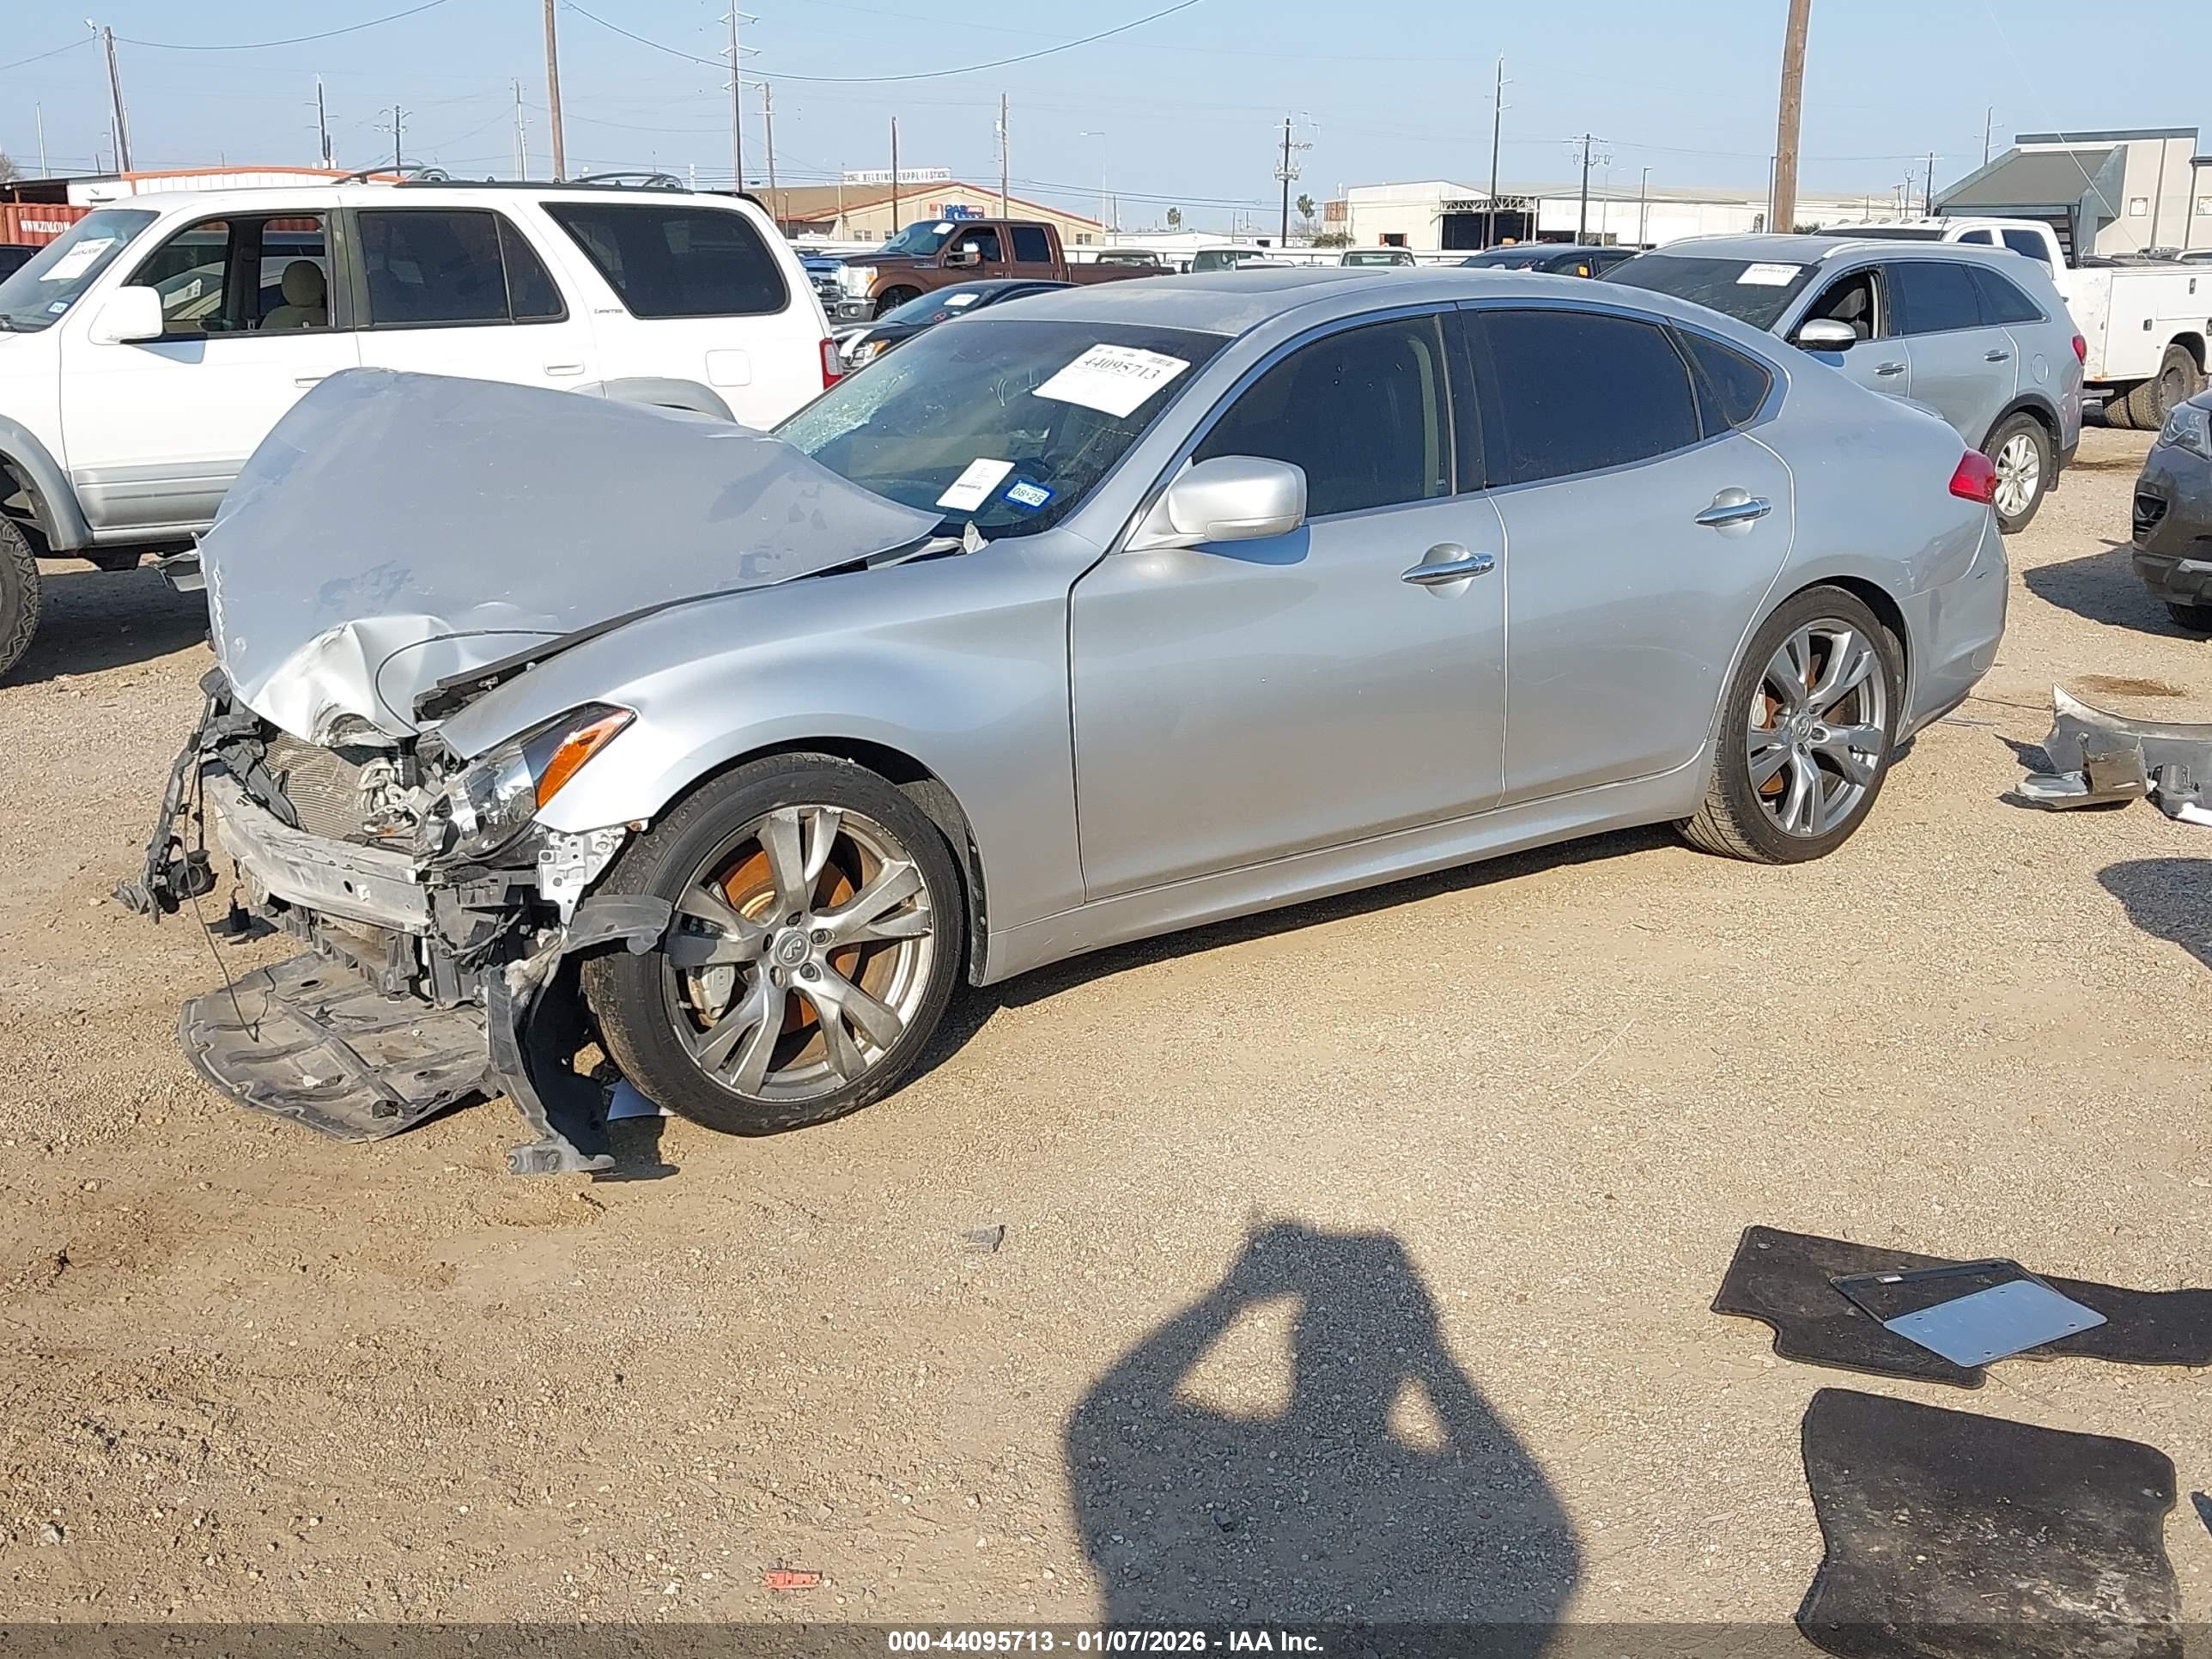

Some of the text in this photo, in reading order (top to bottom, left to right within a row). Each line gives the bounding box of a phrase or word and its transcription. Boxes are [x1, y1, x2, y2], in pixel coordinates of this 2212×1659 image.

[863, 172, 893, 182] WELDING
[898, 170, 935, 181] SUPPLIES
[1083, 356, 1162, 380] 44095713
[1012, 487, 1044, 503] 08 25
